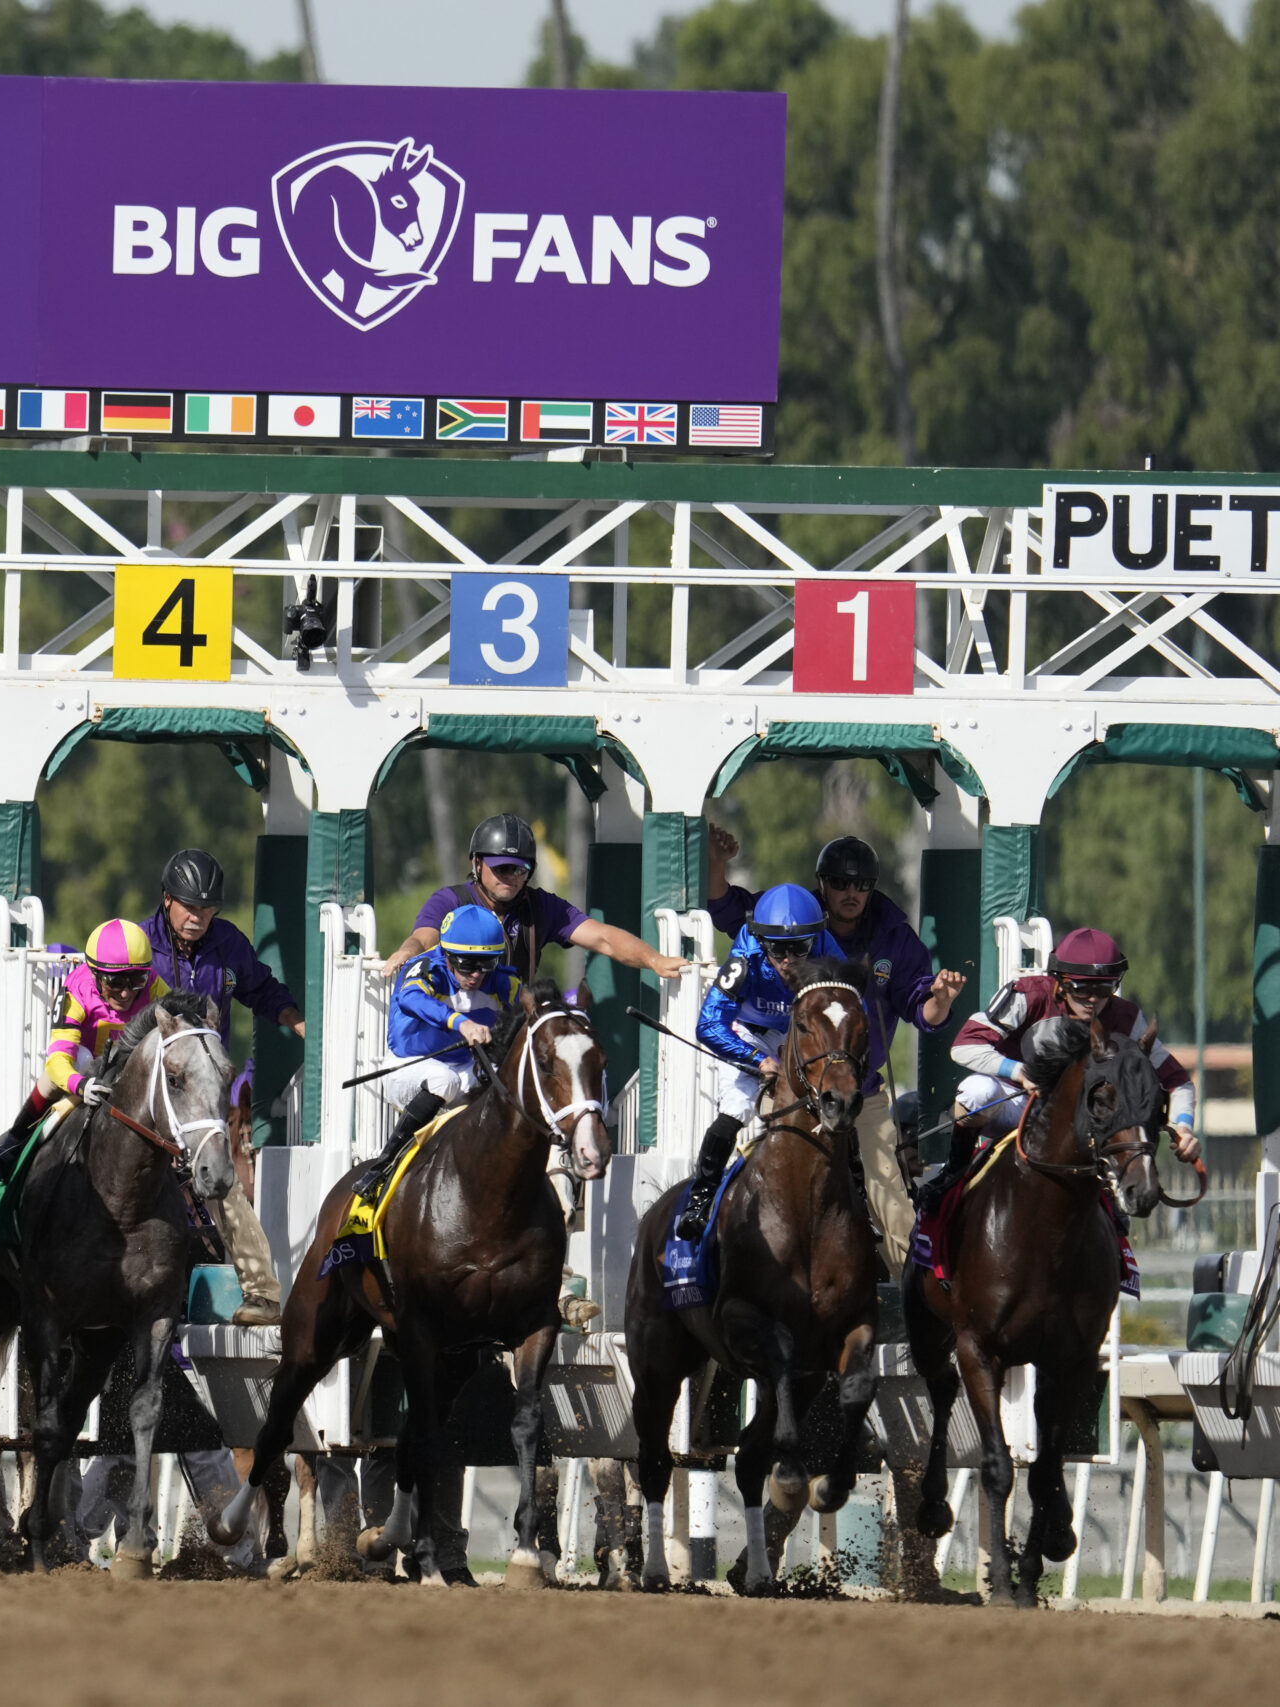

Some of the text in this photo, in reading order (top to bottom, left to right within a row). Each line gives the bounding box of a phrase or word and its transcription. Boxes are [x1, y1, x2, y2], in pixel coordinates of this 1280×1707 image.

[113, 205, 261, 278] BIG
[1053, 491, 1280, 572] PUET
[142, 578, 207, 667] 4
[479, 581, 540, 675] 3
[836, 591, 869, 681] 1
[405, 961, 423, 979] 4
[720, 962, 742, 989] 3
[53, 995, 63, 1024] 5
